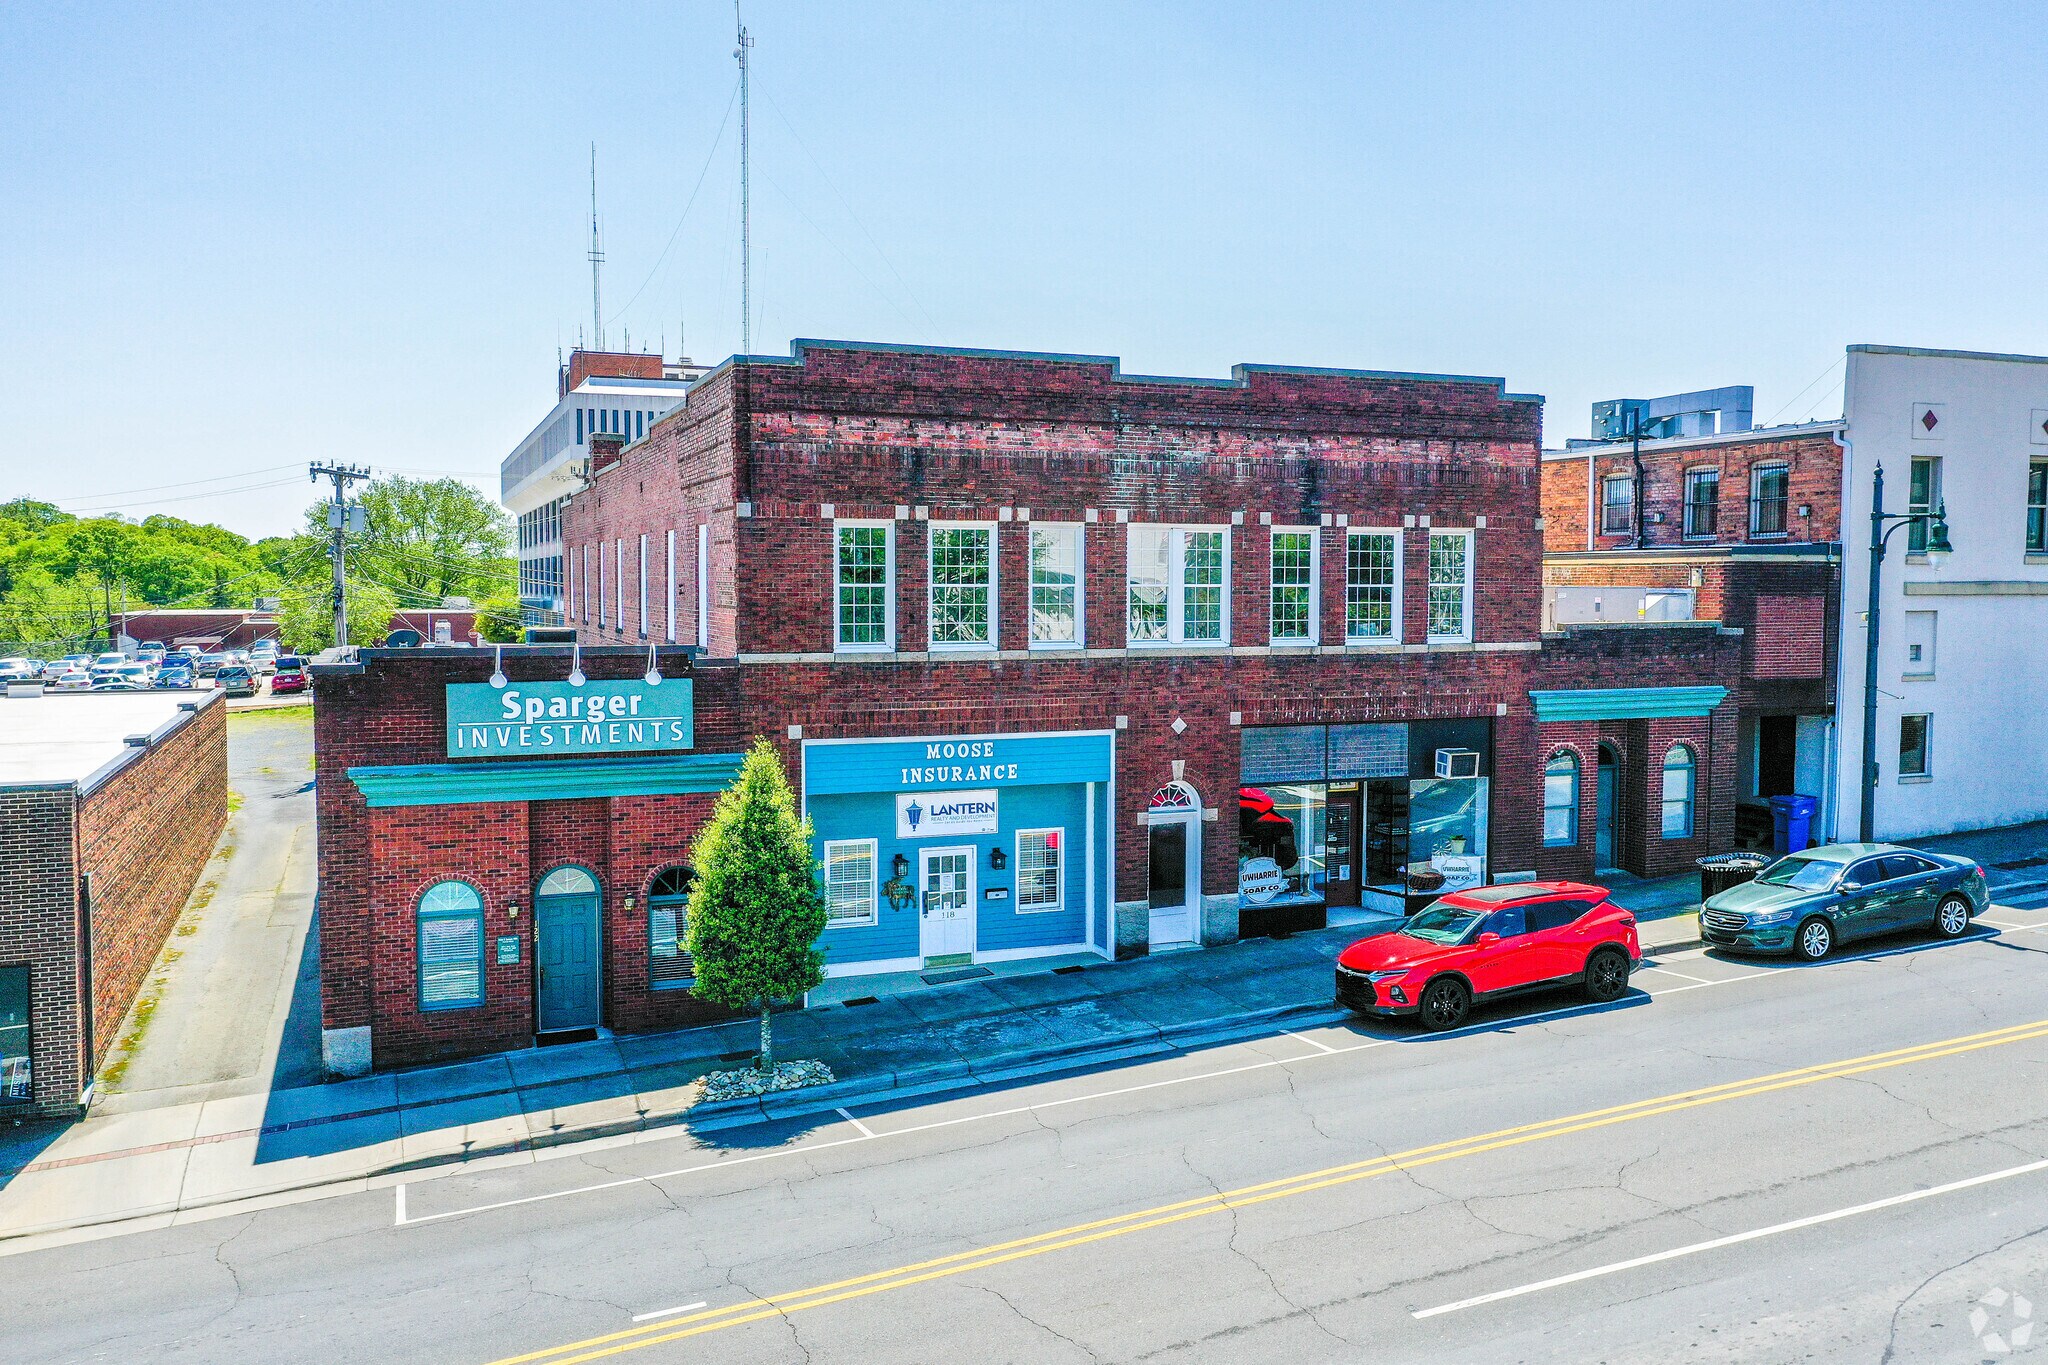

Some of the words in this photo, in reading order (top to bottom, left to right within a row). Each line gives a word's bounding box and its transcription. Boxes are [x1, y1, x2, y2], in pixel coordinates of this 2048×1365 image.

[502, 691, 642, 724] Sparger
[457, 721, 684, 749] INVESTMENTS
[926, 742, 994, 760] MOOSE
[901, 764, 1018, 784] INSURANCE
[930, 801, 996, 816] LANTERN
[1242, 869, 1278, 882] UWHARRIE
[1243, 886, 1267, 895] SOAP
[942, 910, 955, 919] 118
